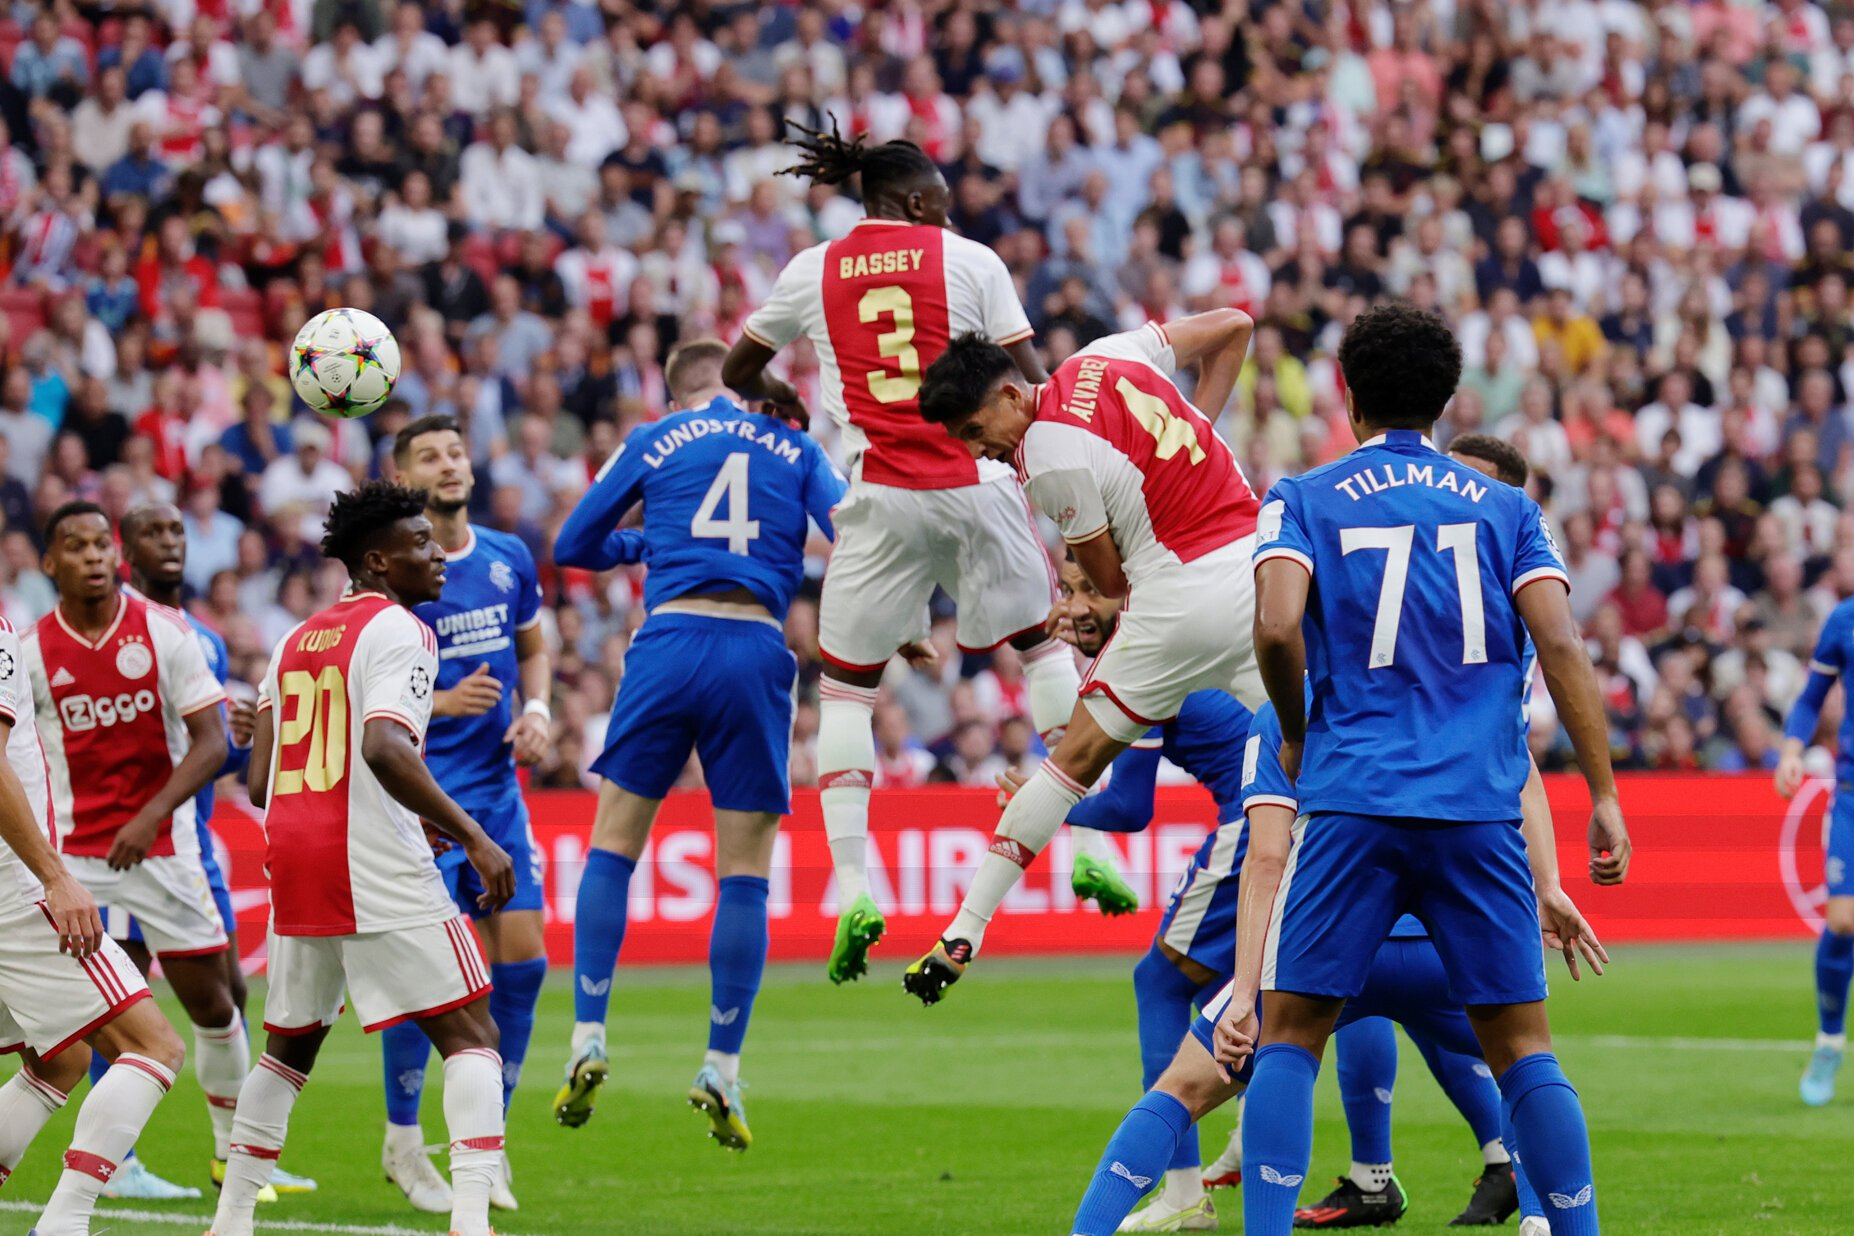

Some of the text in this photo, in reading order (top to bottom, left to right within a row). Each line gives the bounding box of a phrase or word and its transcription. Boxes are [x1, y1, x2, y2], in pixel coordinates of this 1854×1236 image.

[840, 249, 924, 279] BASSEY
[858, 285, 923, 404] 3
[1061, 358, 1110, 424] ÁLVAREZ
[1115, 376, 1207, 466] 4
[642, 419, 802, 470] LUNDSTRAM
[690, 452, 760, 557] 4
[1335, 463, 1488, 503] TILLMAN
[436, 603, 508, 637] UNIBET
[1339, 522, 1489, 670] 71
[296, 624, 347, 653] KUDUS
[274, 665, 347, 796] 20
